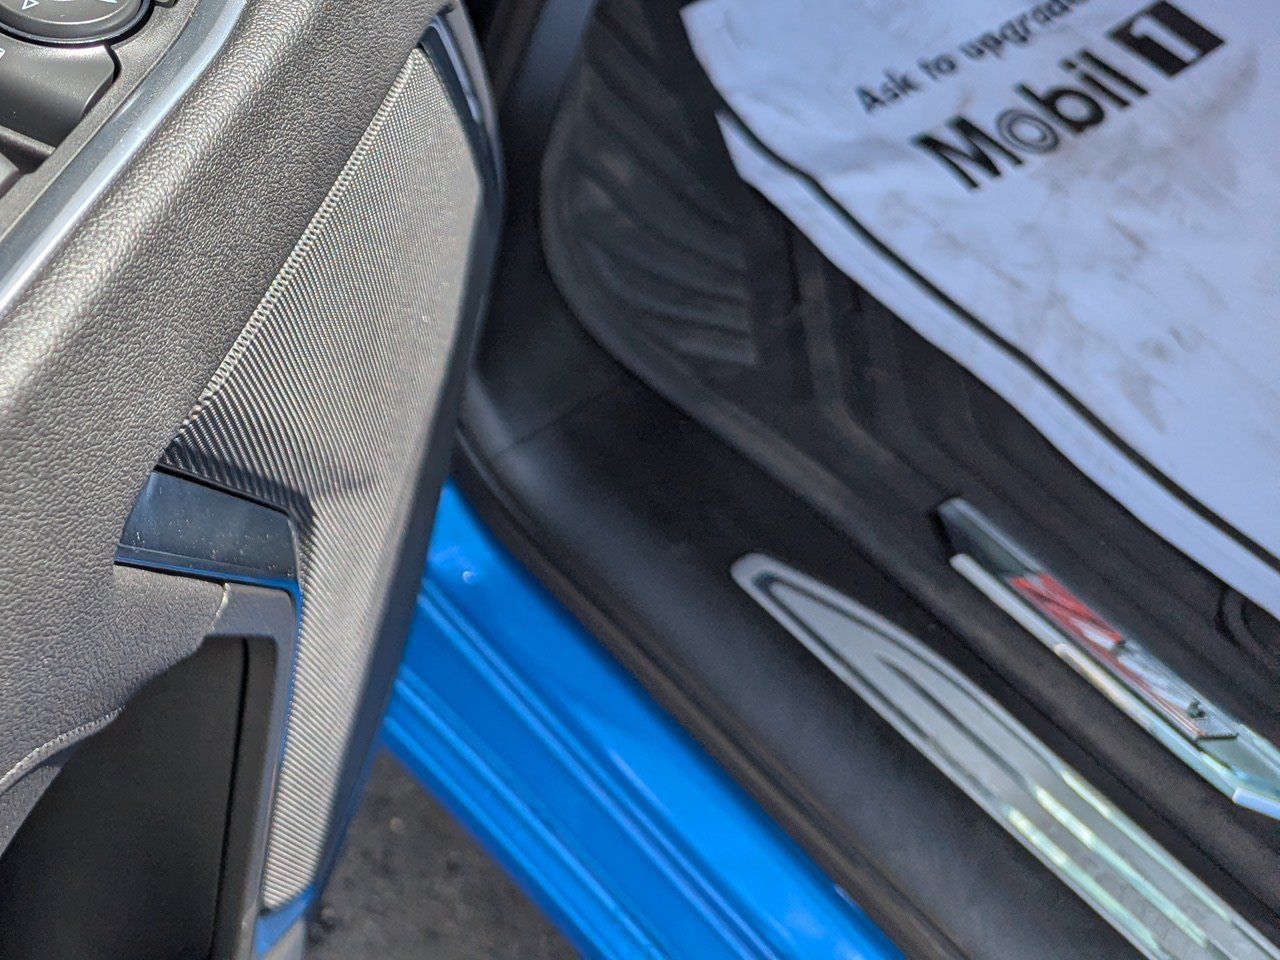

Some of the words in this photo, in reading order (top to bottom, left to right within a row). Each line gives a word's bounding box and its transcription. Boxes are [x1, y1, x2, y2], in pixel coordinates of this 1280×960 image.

[856, 69, 920, 113] Ask
[918, 54, 958, 81] to
[913, 48, 1149, 188] Mobil
